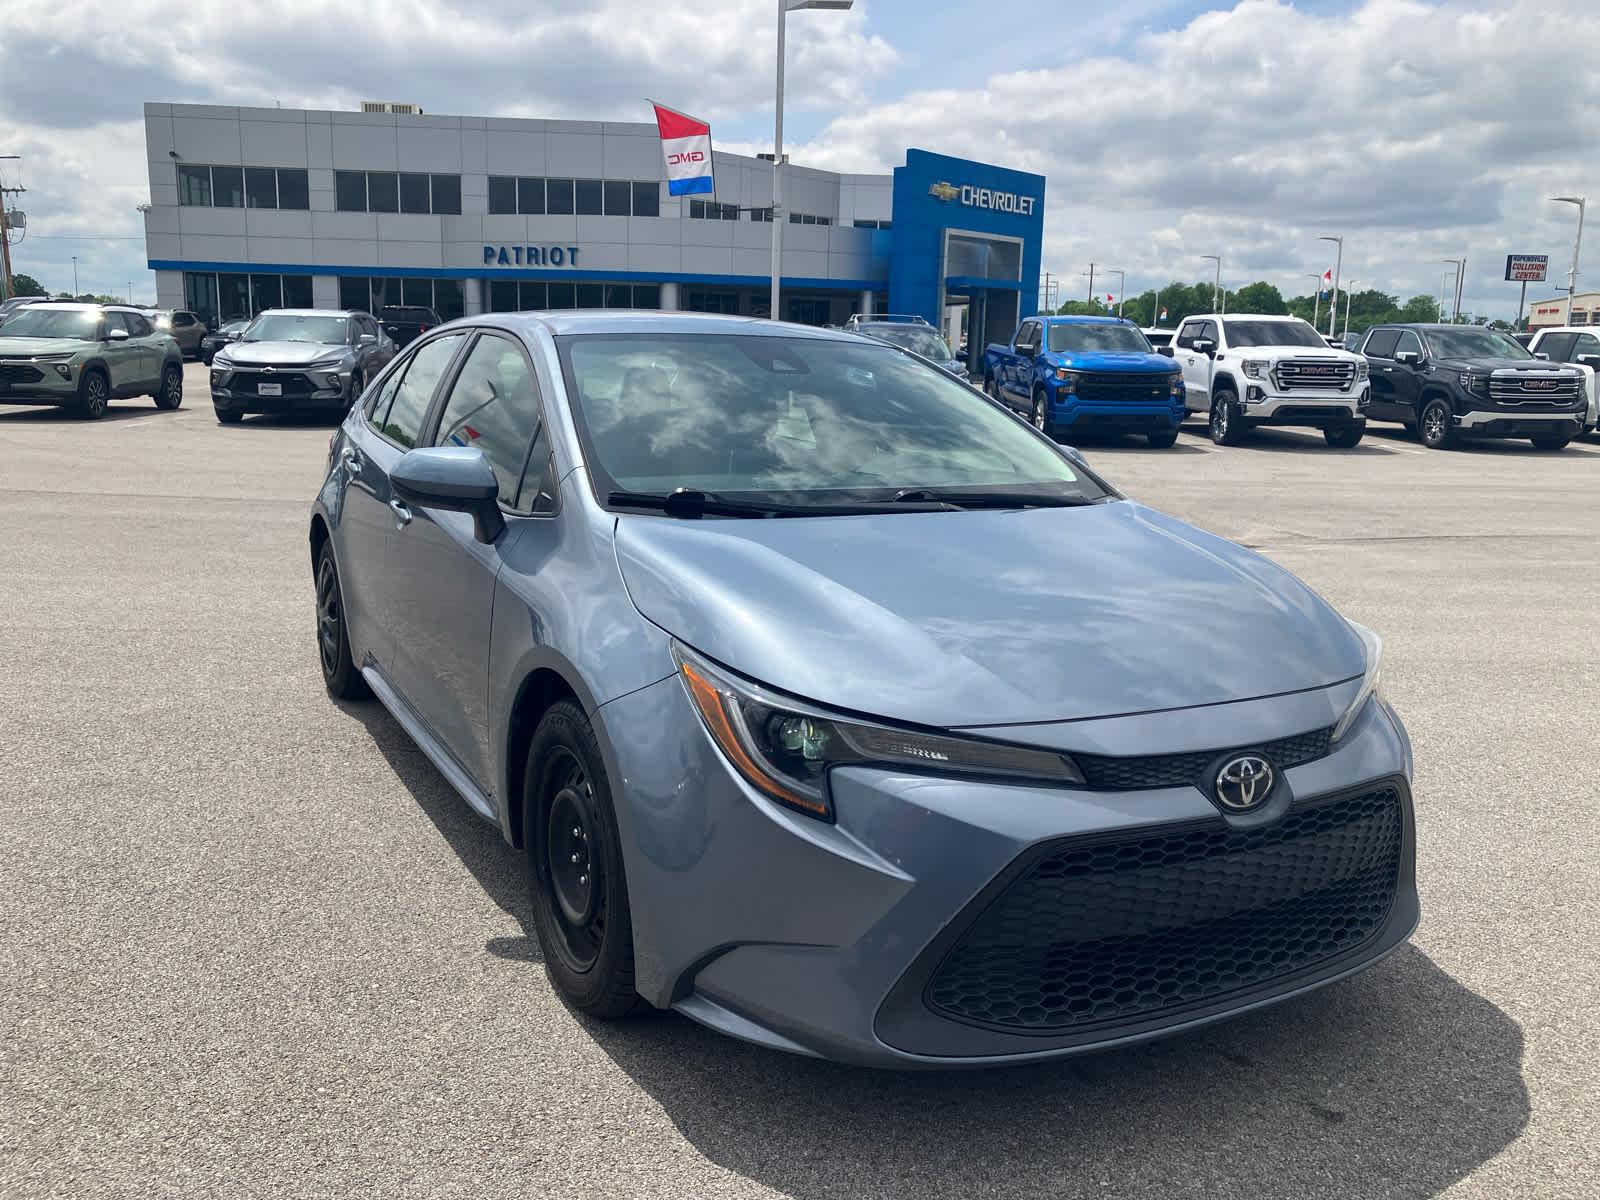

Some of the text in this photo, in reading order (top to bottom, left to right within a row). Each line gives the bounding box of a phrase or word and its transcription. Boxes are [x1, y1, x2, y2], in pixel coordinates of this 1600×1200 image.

[961, 185, 1035, 215] CHEVROLET
[483, 246, 579, 265] PATRIOT
[1512, 262, 1545, 271] COLLISION
[1515, 271, 1541, 279] CENTER
[1524, 380, 1557, 388] GMC
